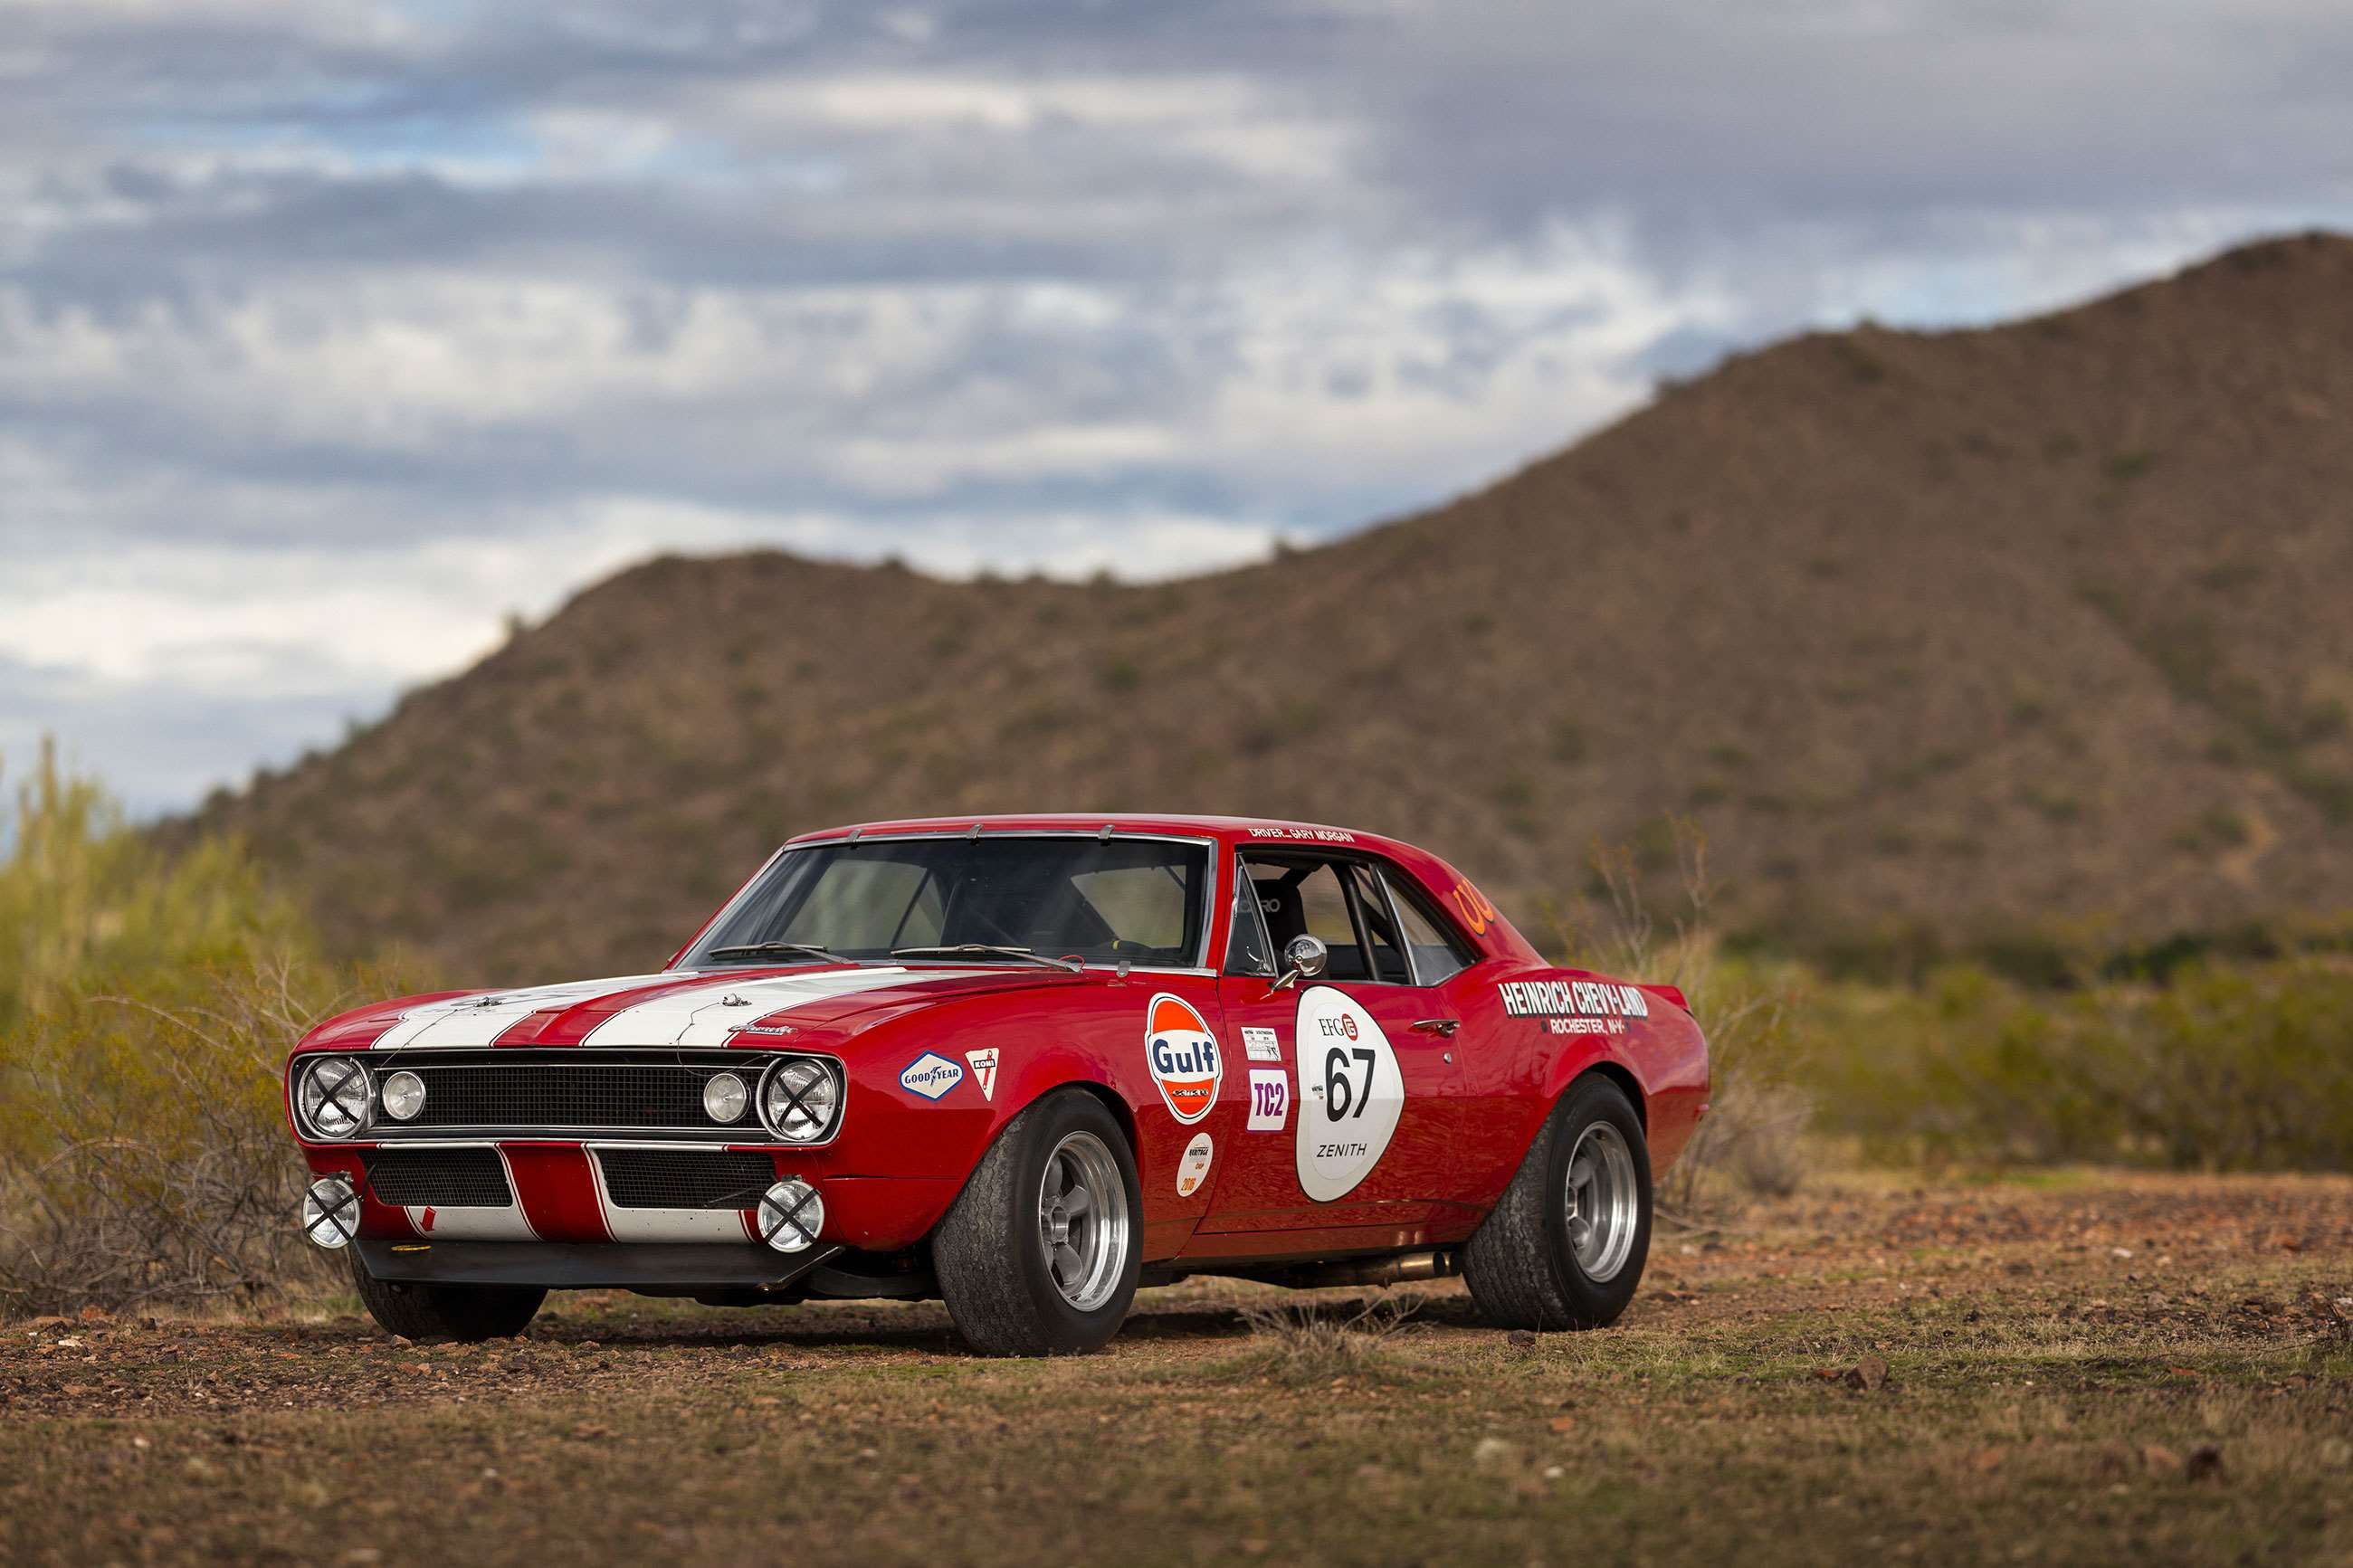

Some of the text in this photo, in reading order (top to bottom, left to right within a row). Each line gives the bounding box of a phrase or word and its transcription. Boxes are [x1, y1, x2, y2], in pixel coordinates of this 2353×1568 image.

[1498, 982, 1575, 1015] HEINRICH
[1318, 1018, 1345, 1036] EFG
[1550, 1019, 1607, 1034] ROCHESTER,
[974, 1060, 996, 1069] KONI
[1152, 1039, 1215, 1074] Gulf
[1325, 1047, 1376, 1122] 67
[1254, 1083, 1284, 1117] TC2
[1317, 1144, 1367, 1157] ZENITH
